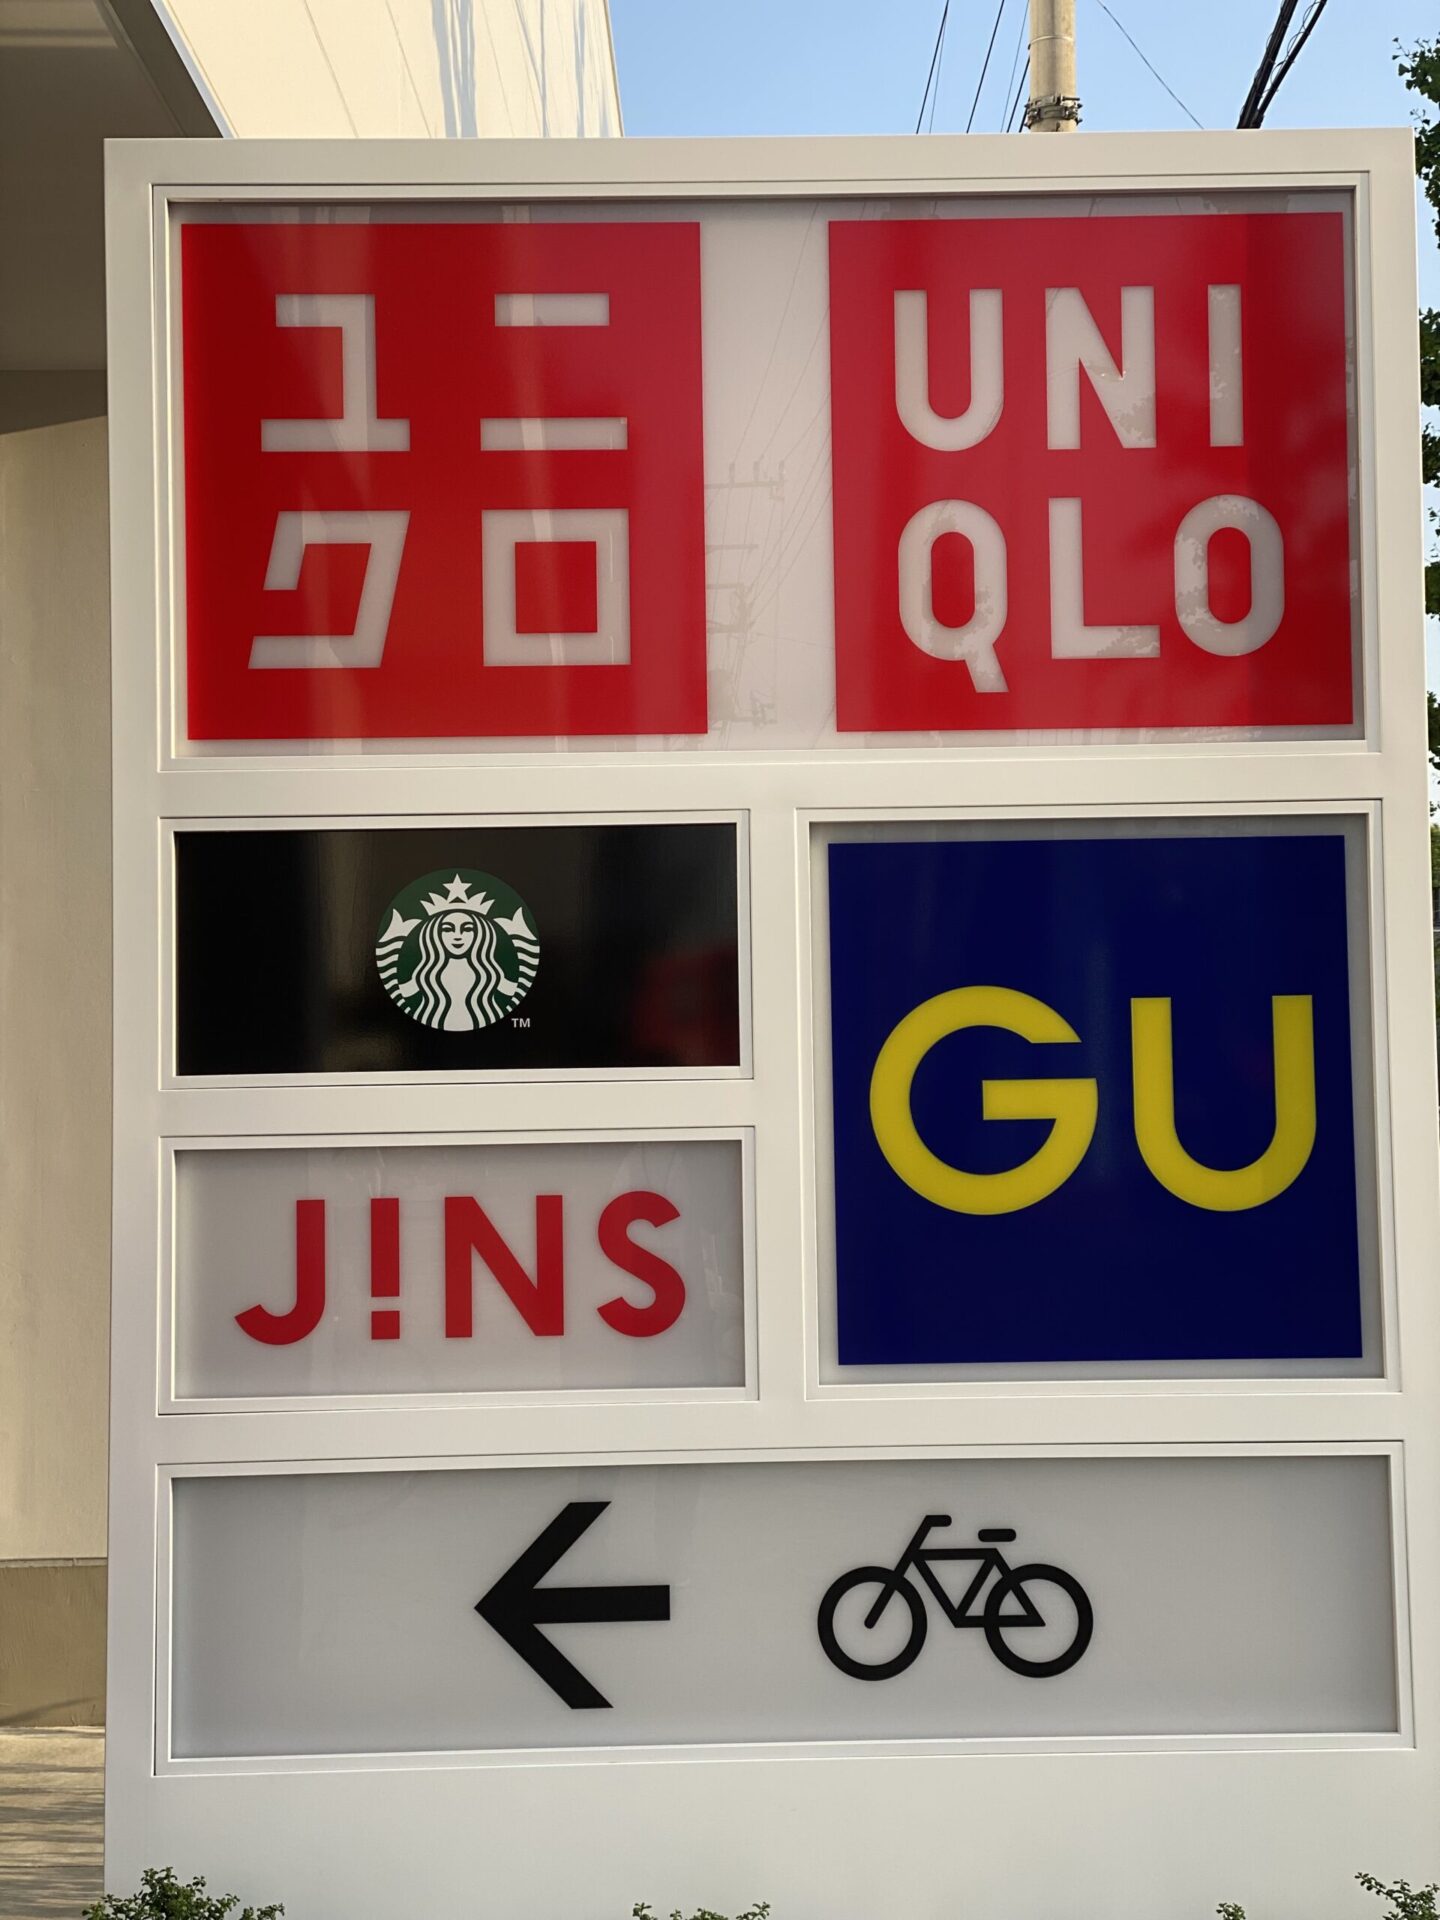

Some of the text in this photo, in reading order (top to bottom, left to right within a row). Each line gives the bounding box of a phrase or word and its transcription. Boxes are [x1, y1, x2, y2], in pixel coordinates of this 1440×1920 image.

[894, 284, 1244, 453] UNI
[898, 494, 1285, 693] QLO
[511, 1017, 531, 1028] TM
[869, 986, 1317, 1216] GU
